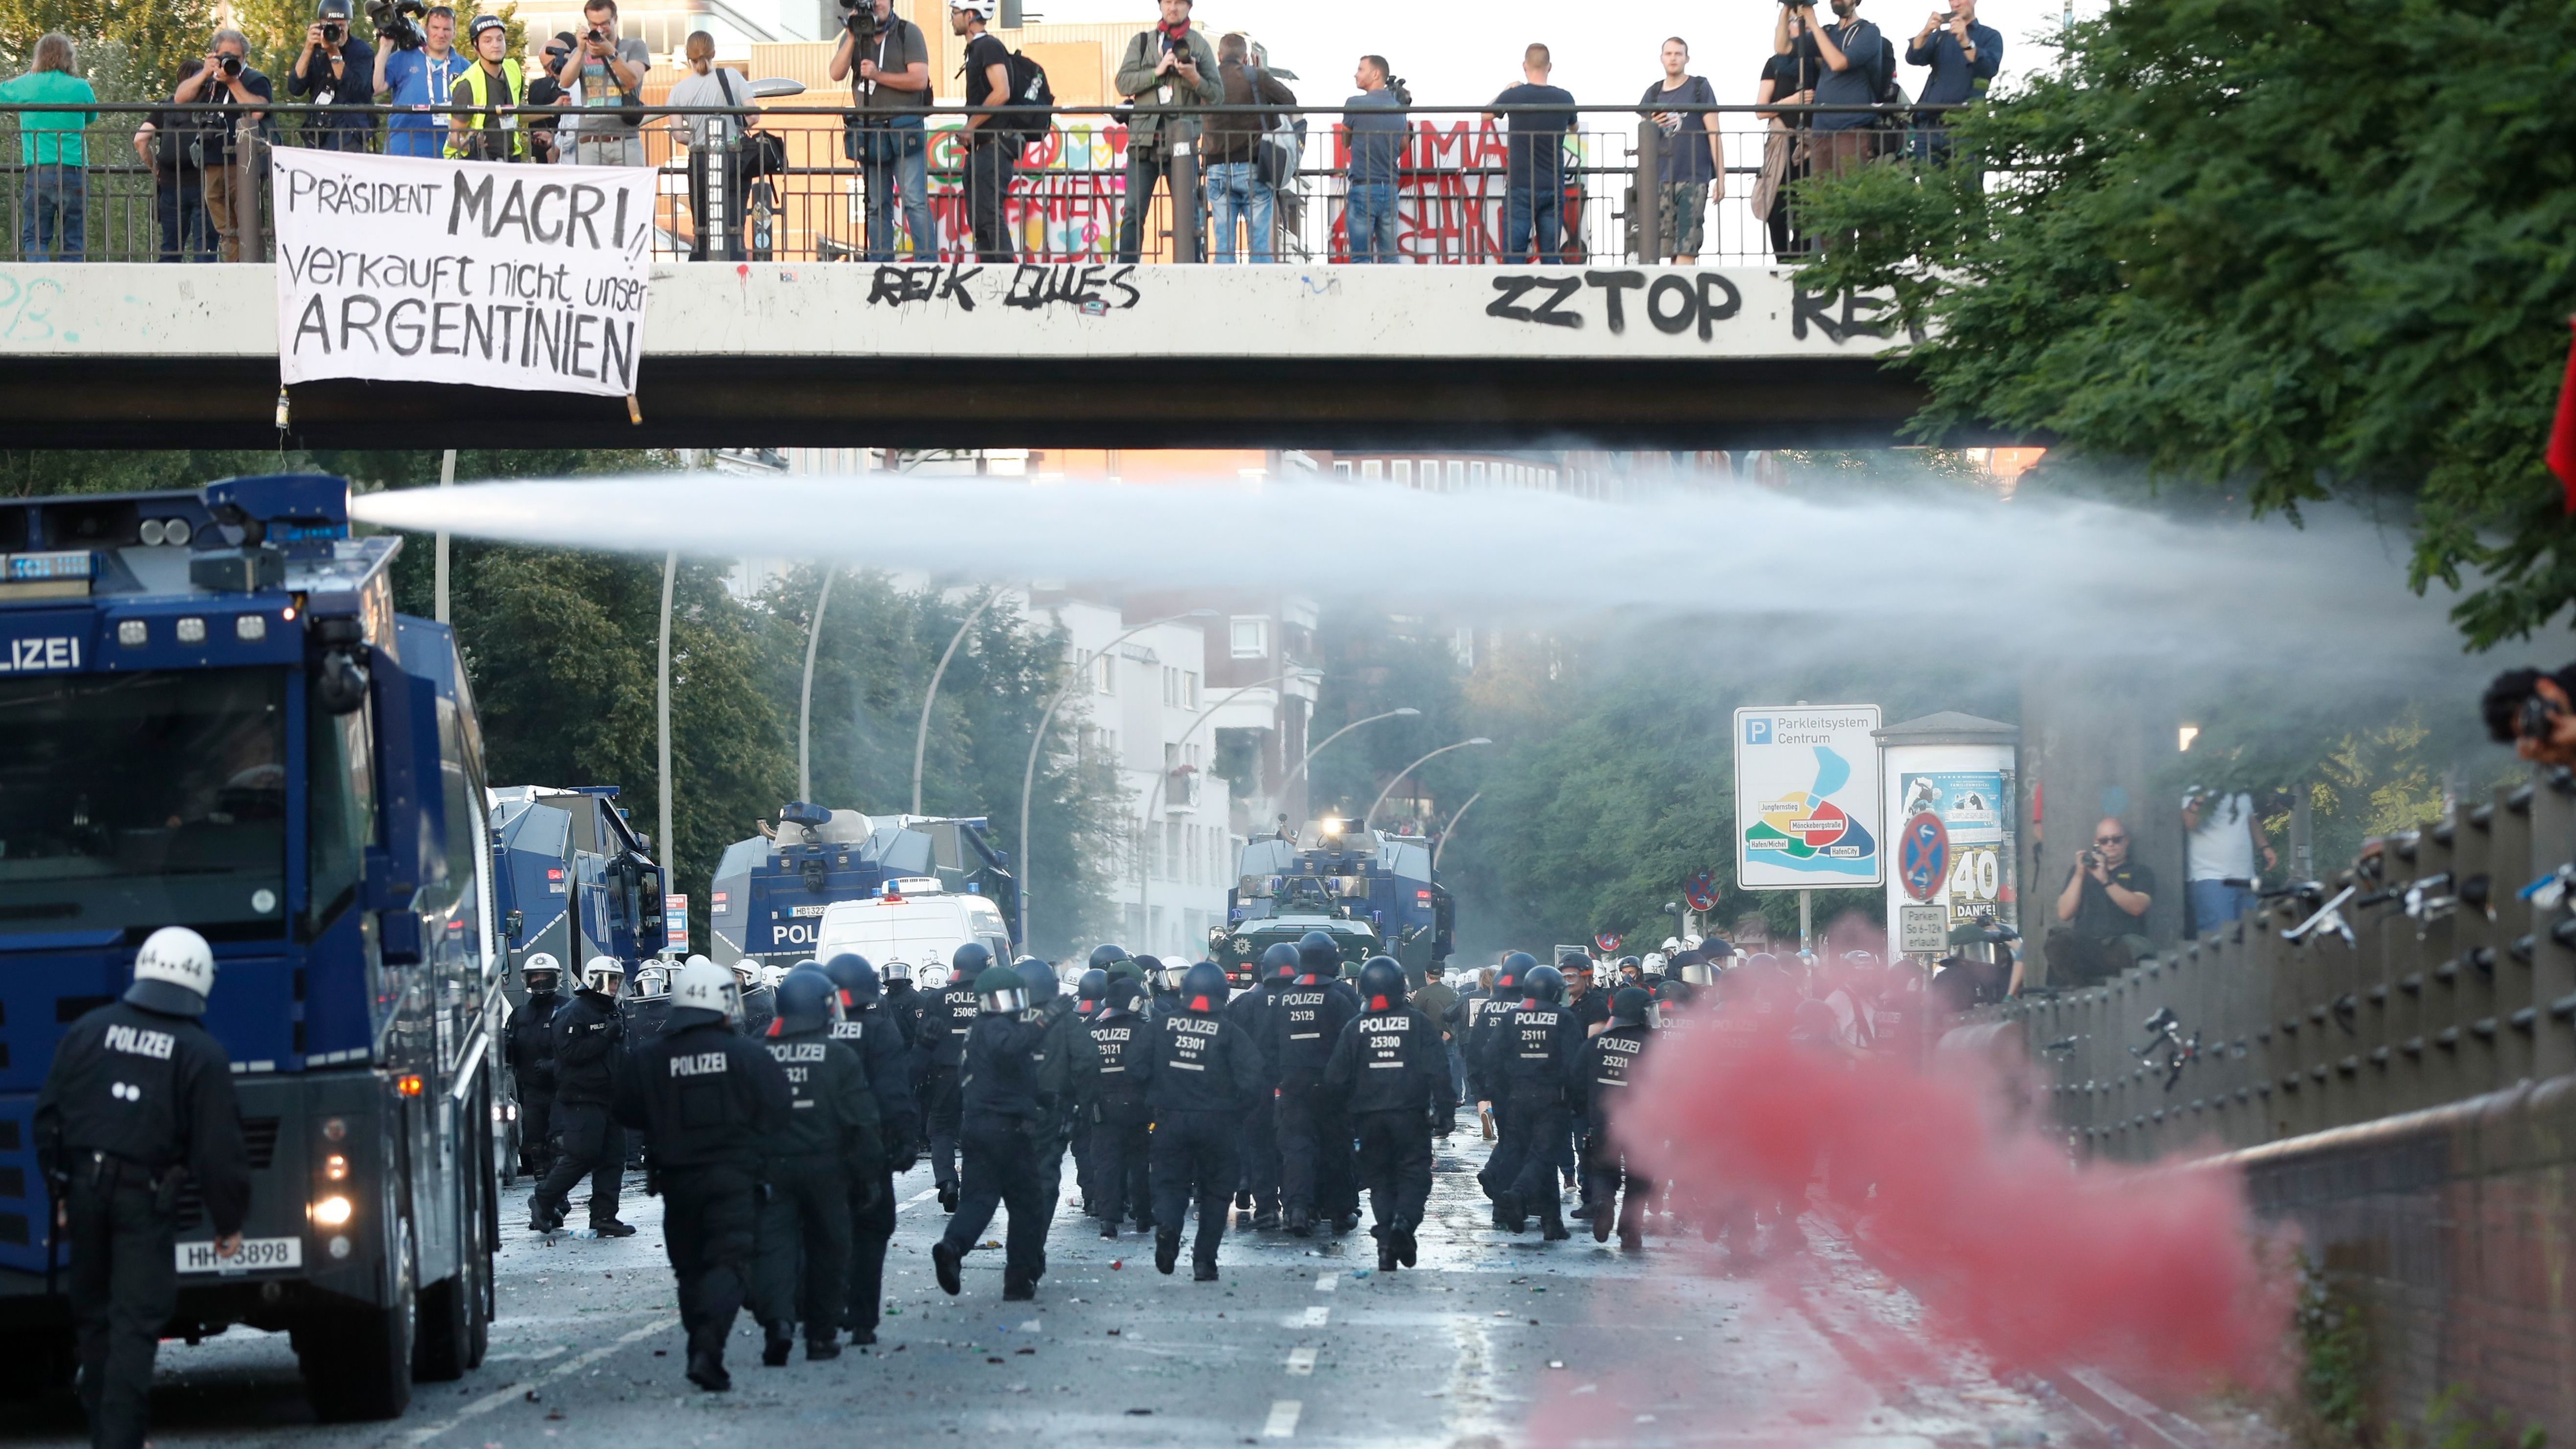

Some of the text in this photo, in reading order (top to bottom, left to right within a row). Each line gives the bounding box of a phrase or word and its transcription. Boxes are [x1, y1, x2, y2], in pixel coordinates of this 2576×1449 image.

[289, 169, 442, 214] PRÄSIDENT
[489, 258, 571, 302] nicht
[585, 275, 648, 312] unser
[1752, 717, 1868, 742] P Parkleitsystem
[1778, 733, 1830, 744] Centrum
[1761, 803, 1798, 812] Jungfernstieg
[1792, 821, 1841, 831] Mönckebergstraße
[1832, 847, 1857, 856] HafenCity
[1952, 850, 1998, 900] 40
[811, 906, 827, 914] 322
[1909, 911, 1939, 921] Parken
[773, 925, 818, 945] POL
[1906, 925, 1917, 934] So
[1909, 937, 1940, 947] erlaubt
[1361, 947, 1369, 960] 2
[686, 984, 706, 998] 44
[1282, 993, 1324, 1006] POLIZEI
[1290, 1010, 1315, 1021] 25129
[1515, 1012, 1558, 1026] POLIZEI
[1166, 1017, 1219, 1035] POLIZEI
[1359, 1016, 1409, 1033] POLIZEI
[1370, 1035, 1401, 1048] 25300
[1522, 1030, 1546, 1040] 25111
[105, 1024, 175, 1060] POLIZEI
[1175, 1035, 1205, 1051] 25301
[1597, 1037, 1641, 1054] POLIZEI
[670, 1052, 727, 1077] POLIZEI
[1602, 1055, 1628, 1068] 25221
[188, 1241, 288, 1266] HH 3898
